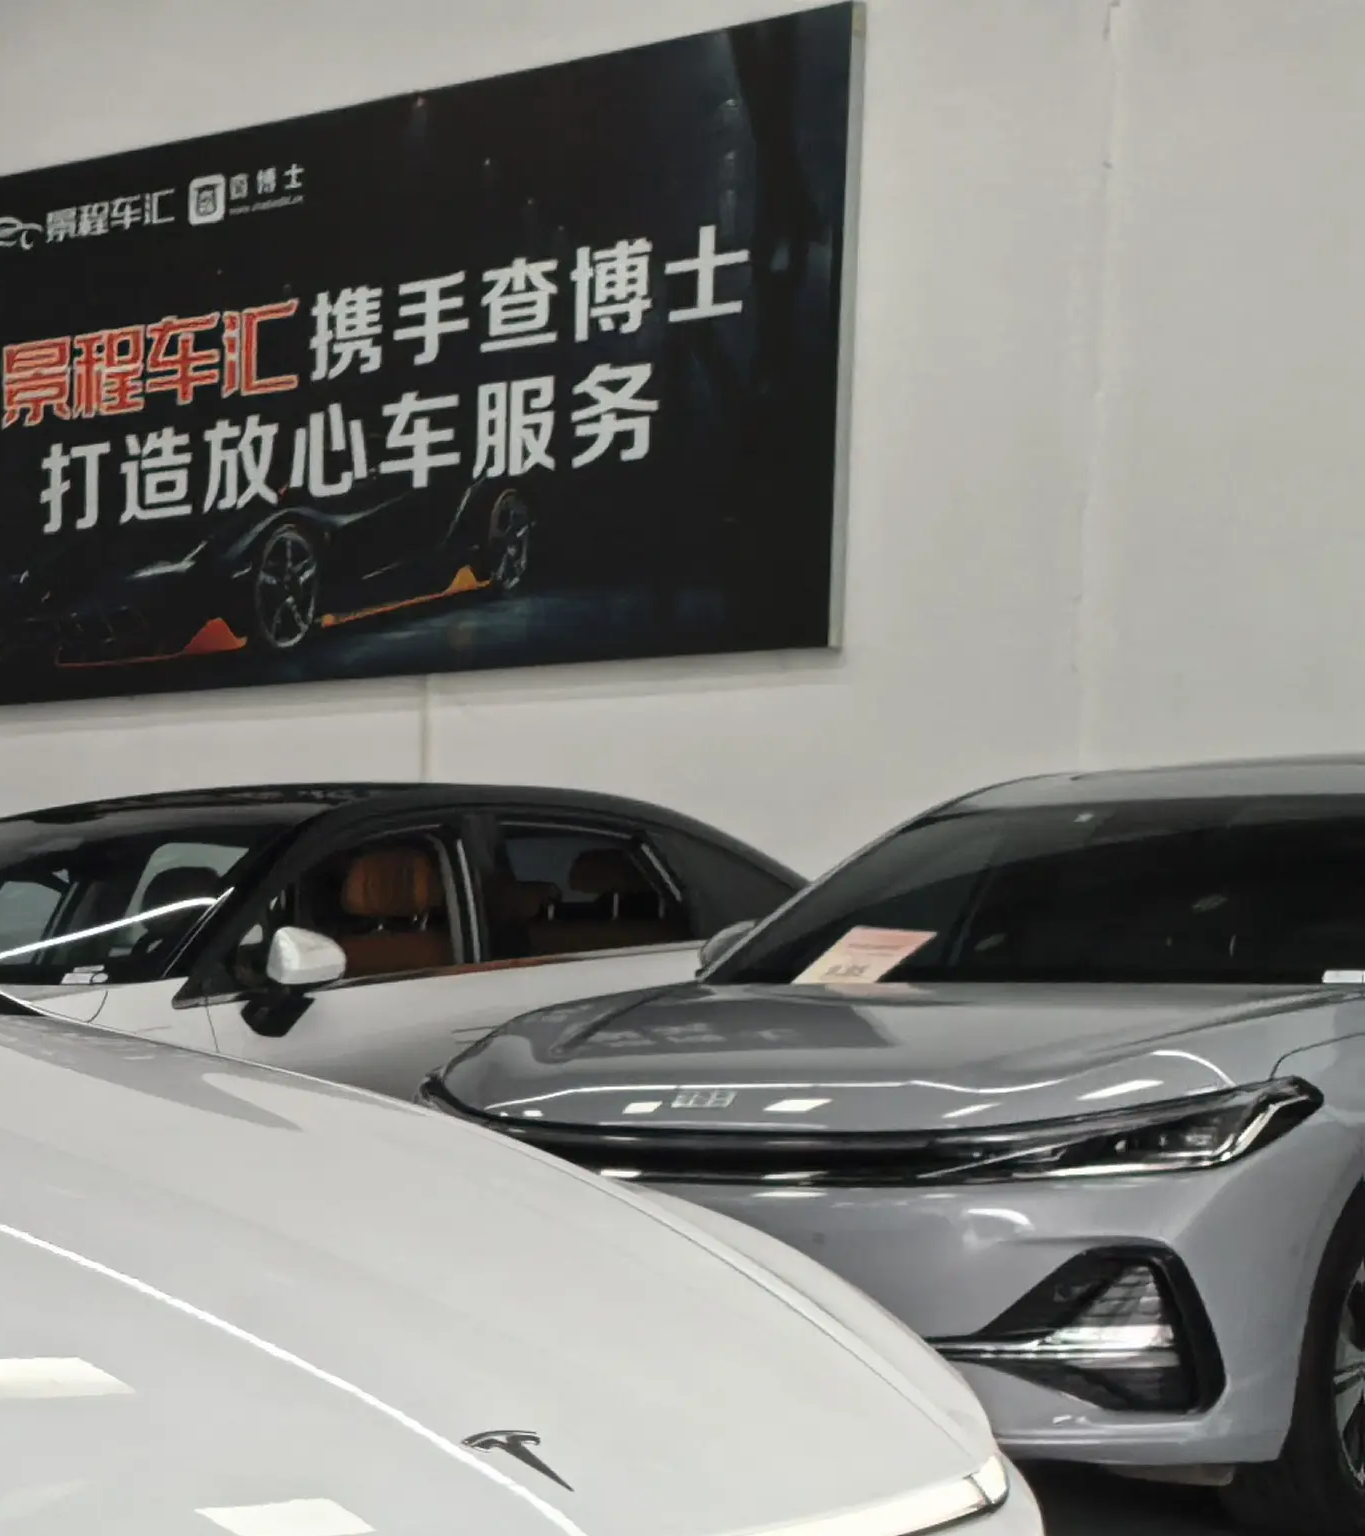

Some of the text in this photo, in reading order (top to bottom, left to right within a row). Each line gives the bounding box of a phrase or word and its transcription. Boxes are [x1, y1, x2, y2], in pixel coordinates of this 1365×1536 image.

[39, 362, 660, 536] 打造放心车服务
